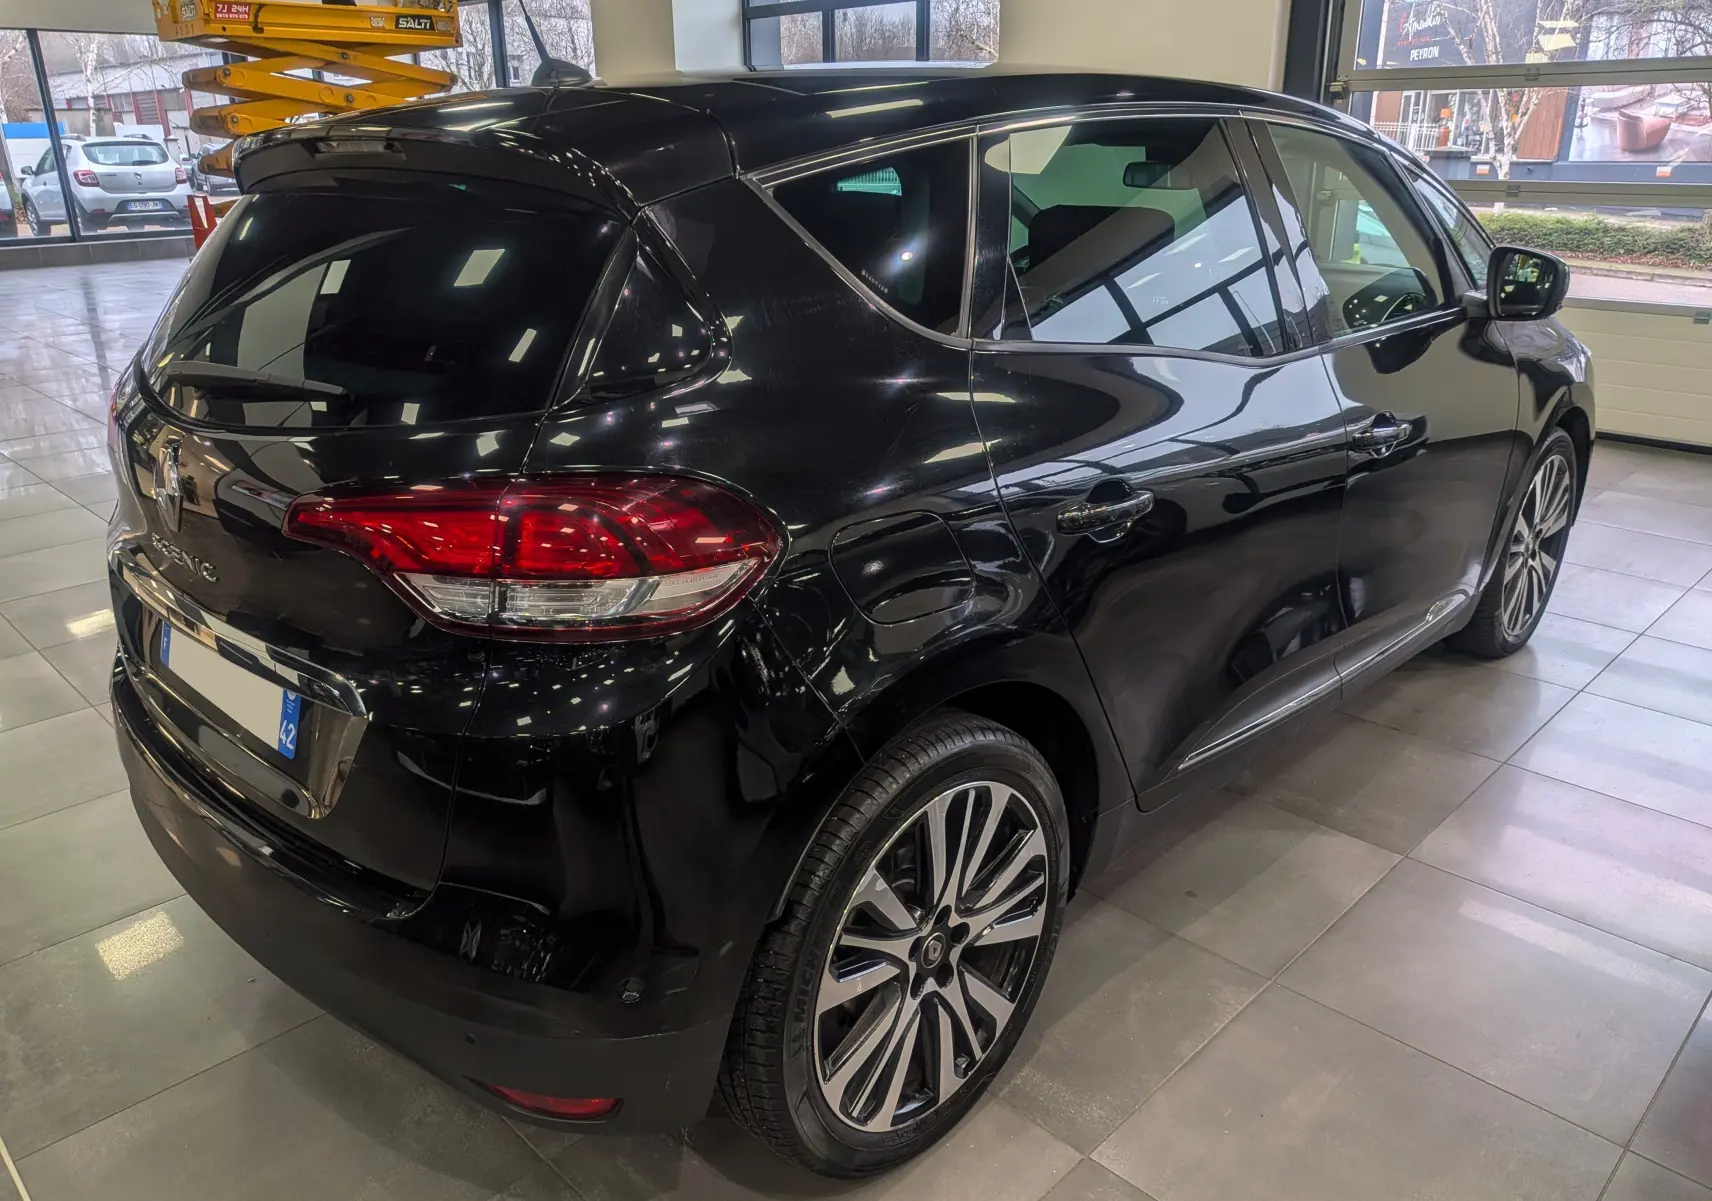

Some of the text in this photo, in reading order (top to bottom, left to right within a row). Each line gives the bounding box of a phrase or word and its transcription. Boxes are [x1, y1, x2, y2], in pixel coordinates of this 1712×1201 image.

[231, 4, 249, 13] 24H
[1410, 46, 1440, 61] PEYRON
[280, 719, 296, 750] 42
